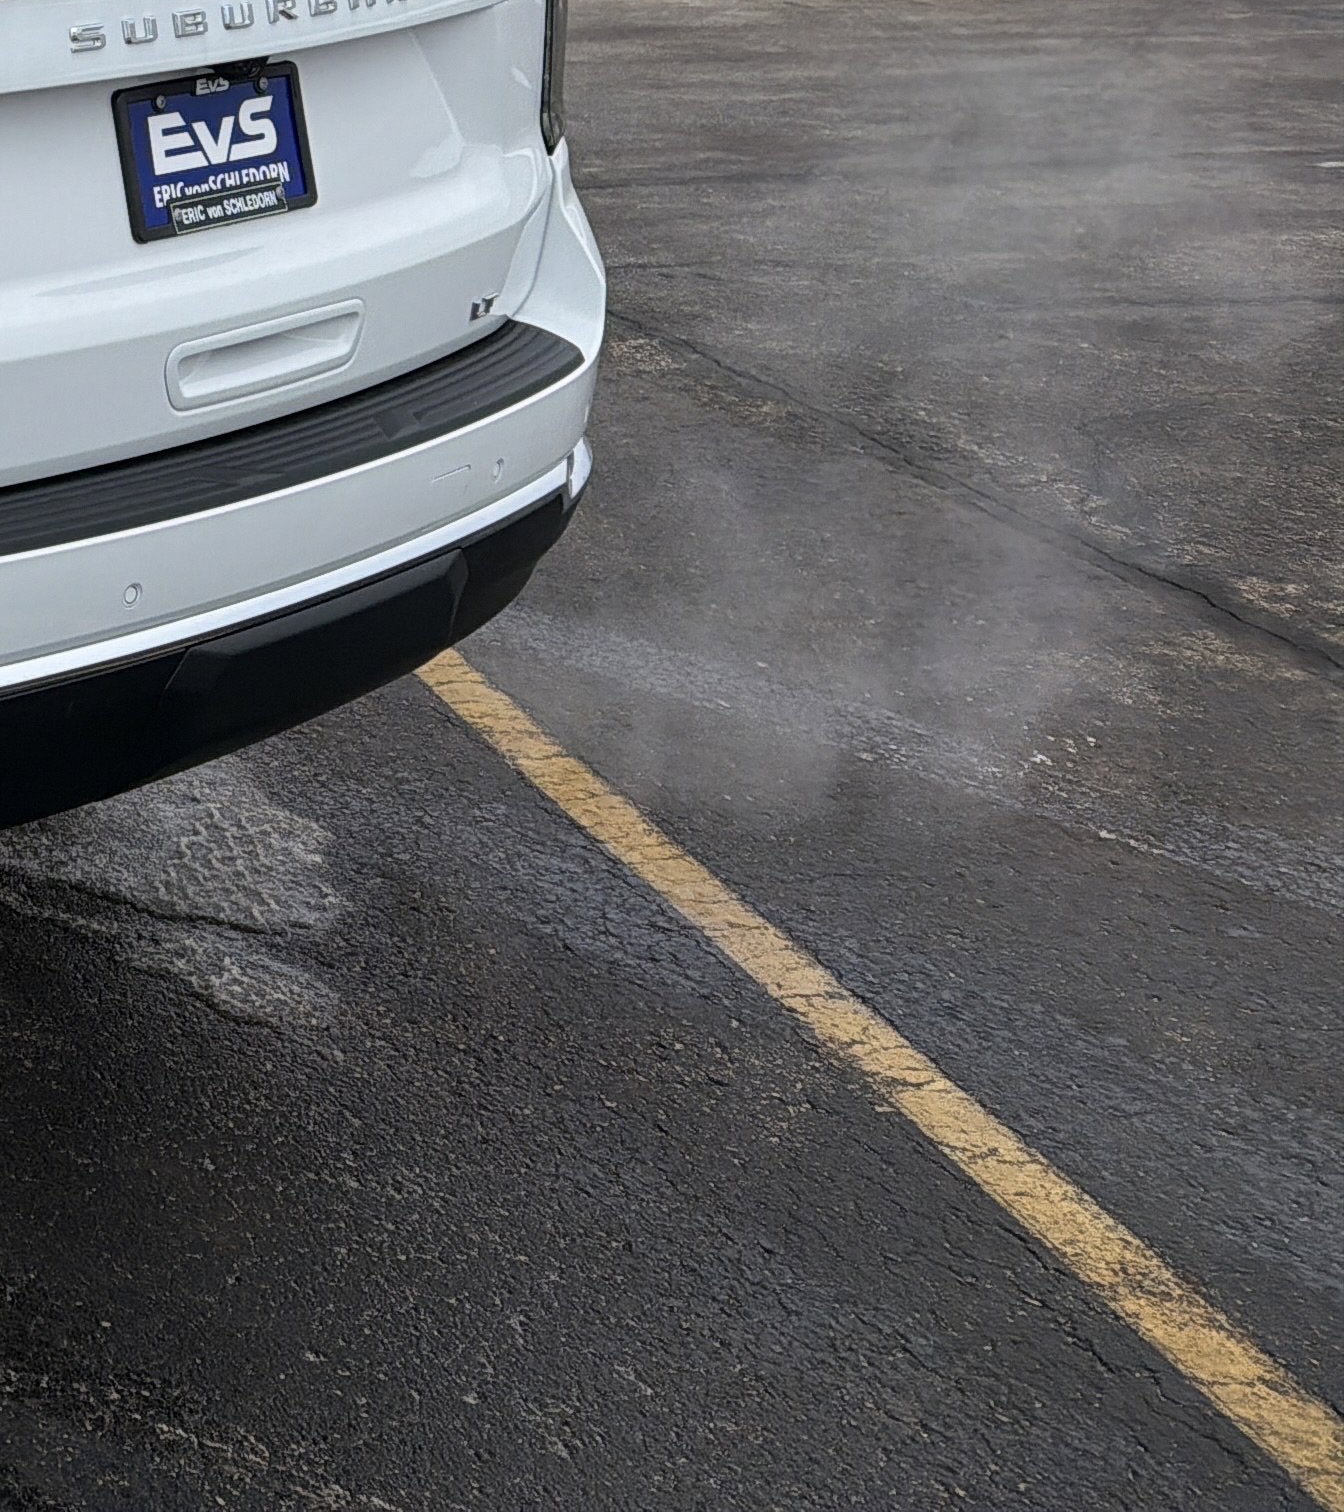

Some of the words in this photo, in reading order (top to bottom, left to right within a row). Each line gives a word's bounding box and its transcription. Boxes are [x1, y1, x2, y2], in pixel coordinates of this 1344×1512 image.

[182, 205, 205, 224] ERIC
[207, 204, 224, 220] von
[223, 191, 278, 215] SCHLEDORN
[469, 292, 499, 321] LT
